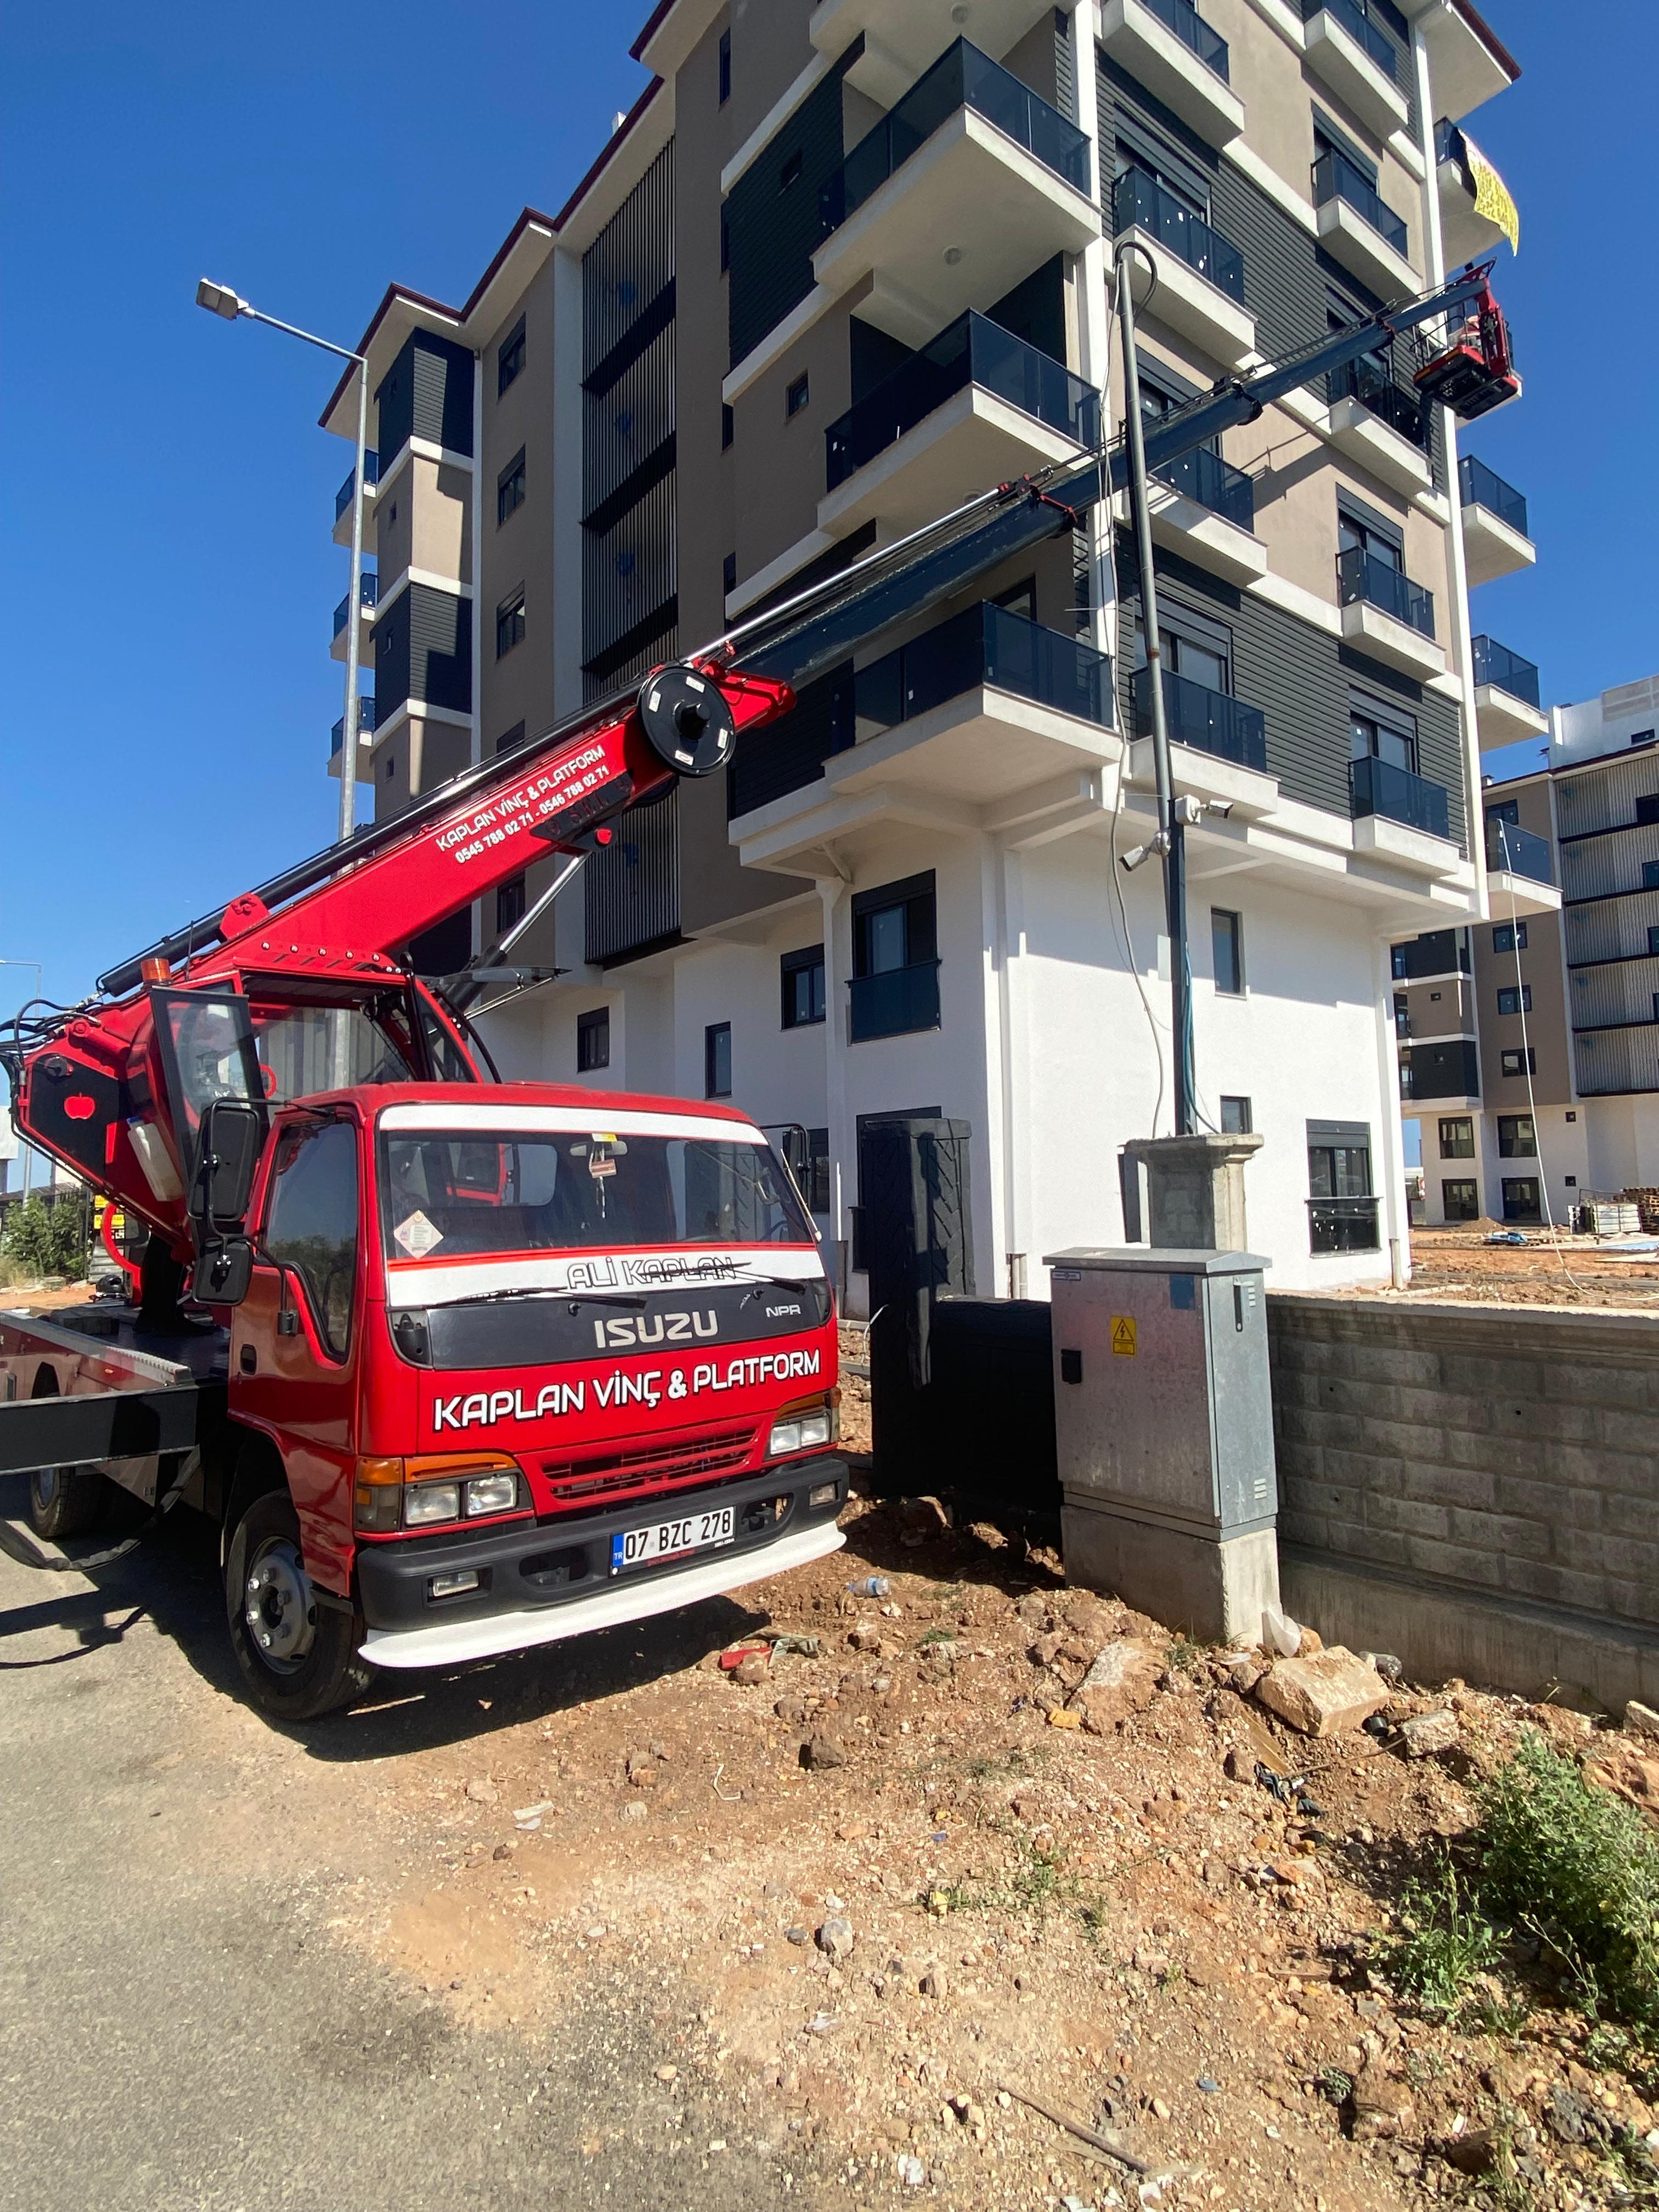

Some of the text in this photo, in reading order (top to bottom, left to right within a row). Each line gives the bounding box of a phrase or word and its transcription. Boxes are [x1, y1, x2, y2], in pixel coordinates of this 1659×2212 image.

[435, 744, 606, 852] KAPLAN VİNÇ & PLATFORM
[455, 840, 484, 864] 0545
[482, 829, 506, 848] 788
[504, 820, 521, 835] 02
[517, 811, 534, 827] 71
[539, 793, 566, 815] 0546
[563, 781, 584, 799] 788
[582, 772, 597, 787] 02
[595, 765, 610, 779] 71
[567, 1256, 737, 1289] ALİ KAPLAN
[594, 1310, 718, 1348] ISUZU
[765, 1304, 801, 1317] NPR
[435, 1348, 820, 1430] KAPLAN VİNÇ & PLATFORM
[614, 1551, 623, 1560] TR
[625, 1531, 649, 1559] 07
[659, 1520, 692, 1551] BZC
[701, 1510, 731, 1541] 278
